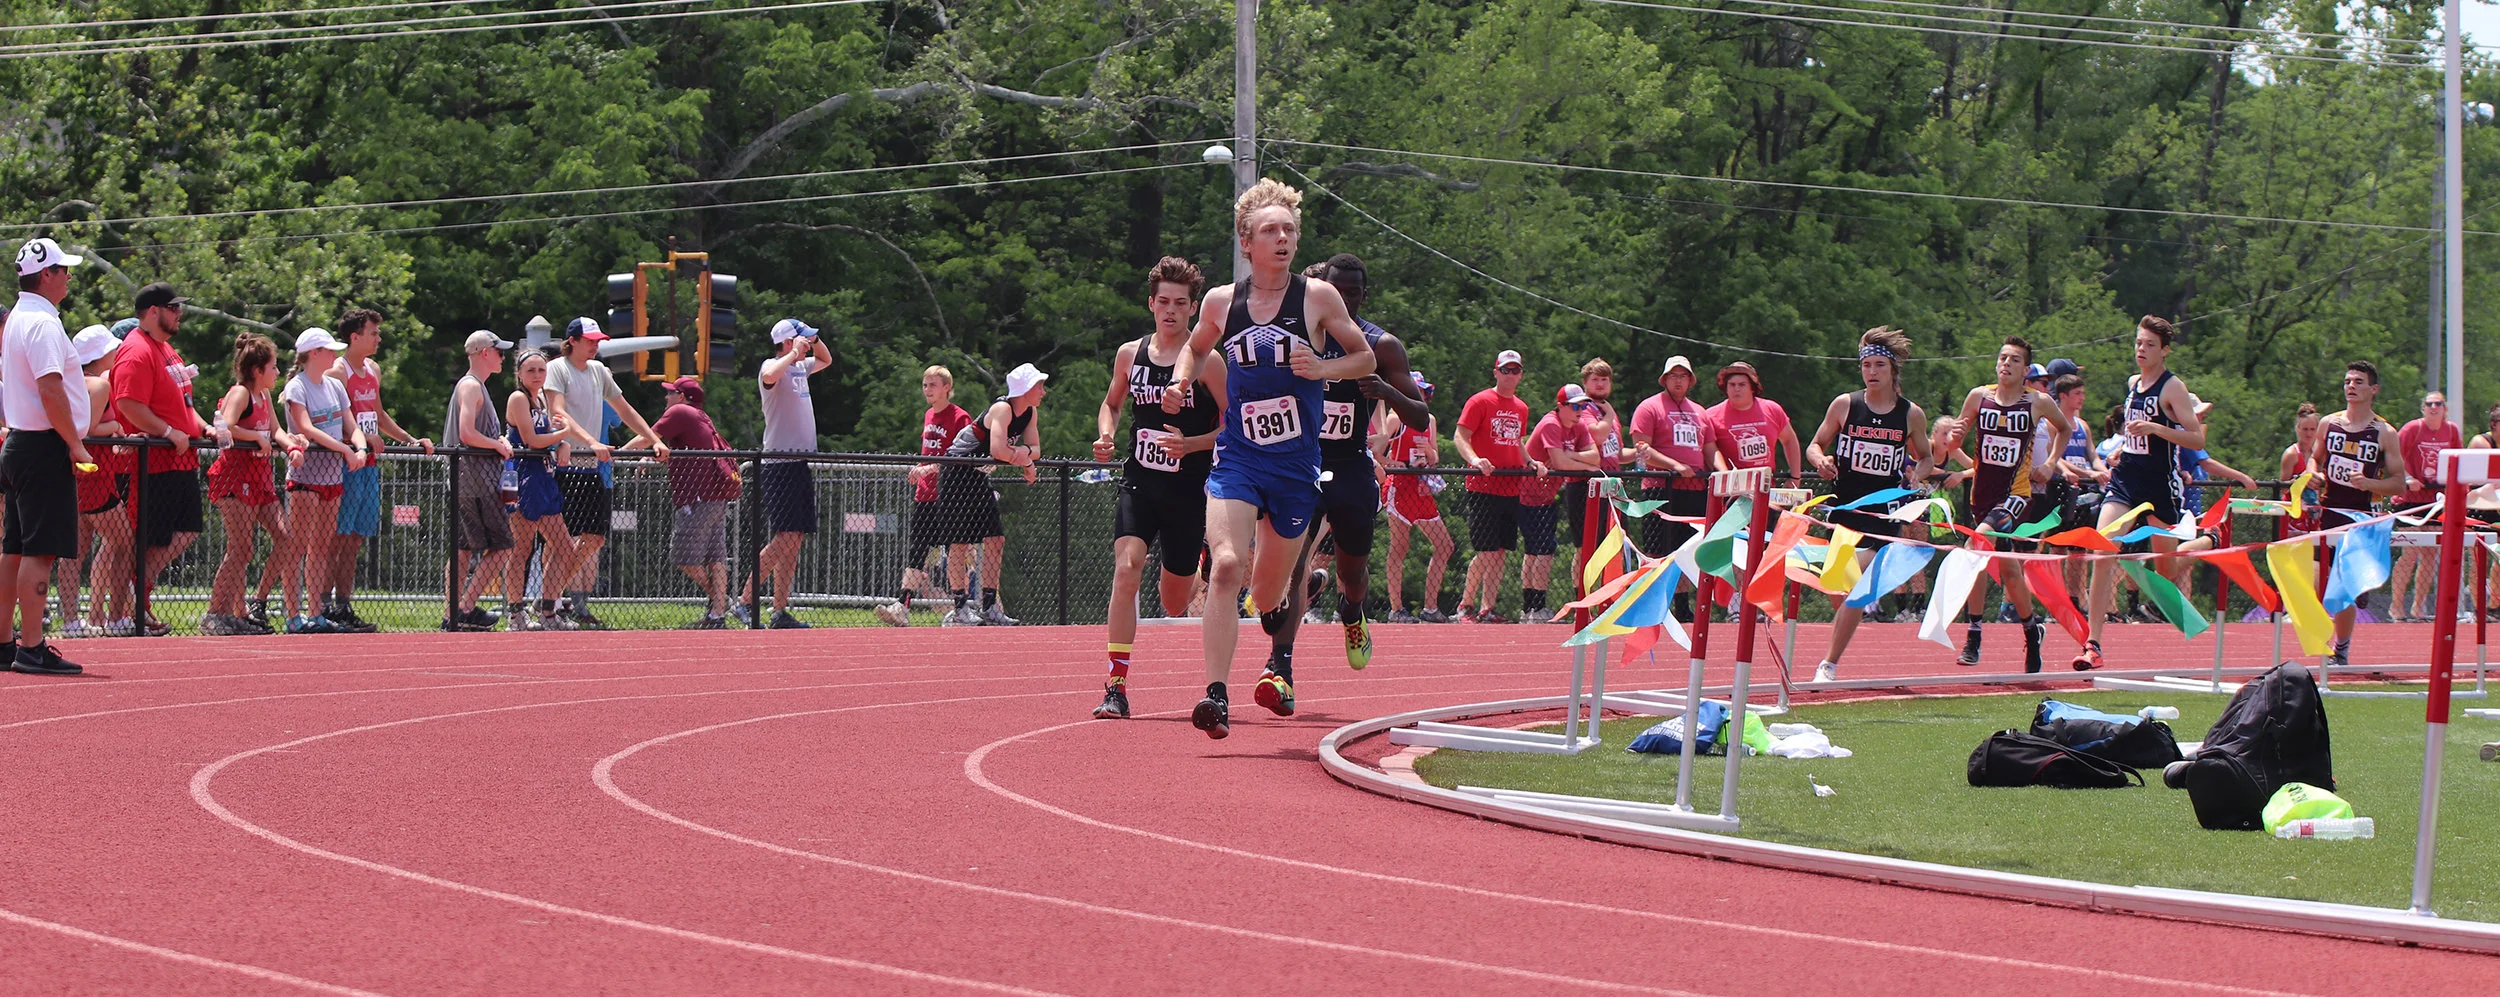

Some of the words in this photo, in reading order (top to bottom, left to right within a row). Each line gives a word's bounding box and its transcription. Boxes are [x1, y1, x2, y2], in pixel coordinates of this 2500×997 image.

[1132, 366, 1145, 393] 4
[2144, 397, 2156, 416] 8
[1244, 409, 1296, 440] 1391
[1980, 410, 1999, 429] 10
[2008, 413, 2029, 431] 10
[1675, 431, 1697, 444] 1104
[1848, 424, 1904, 441] LICKING
[1741, 442, 1766, 457] 1099
[1842, 437, 1849, 457] 7
[1983, 444, 2016, 463] 1331
[2328, 434, 2345, 451] 13
[2360, 444, 2378, 461] 13
[1854, 451, 1891, 472] 1205
[2330, 464, 2358, 483] 133
[2171, 480, 2179, 498] 8
[2007, 497, 2025, 517] 10
